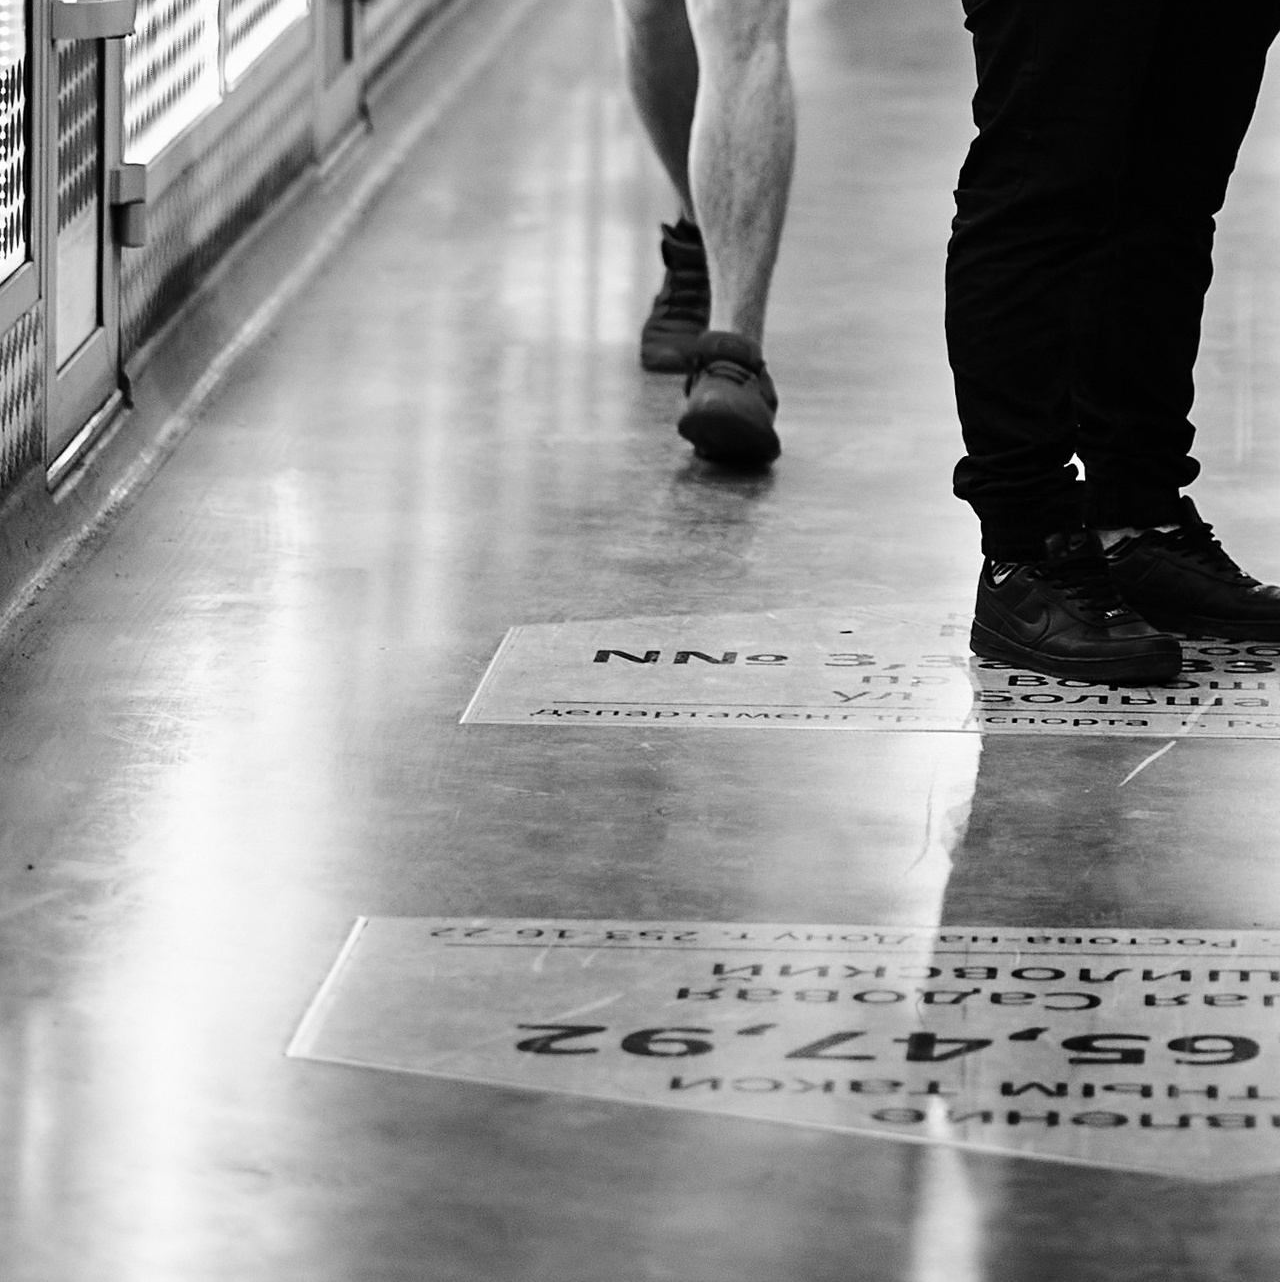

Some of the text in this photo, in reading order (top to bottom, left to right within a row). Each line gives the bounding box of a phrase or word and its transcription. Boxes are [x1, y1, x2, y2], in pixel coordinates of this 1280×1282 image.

[529, 707, 858, 724] департамент
[872, 714, 1150, 728] трспорта
[773, 931, 1239, 949] Ростова-наДону
[676, 986, 1103, 1012] Садовая
[667, 1074, 958, 1098] такси
